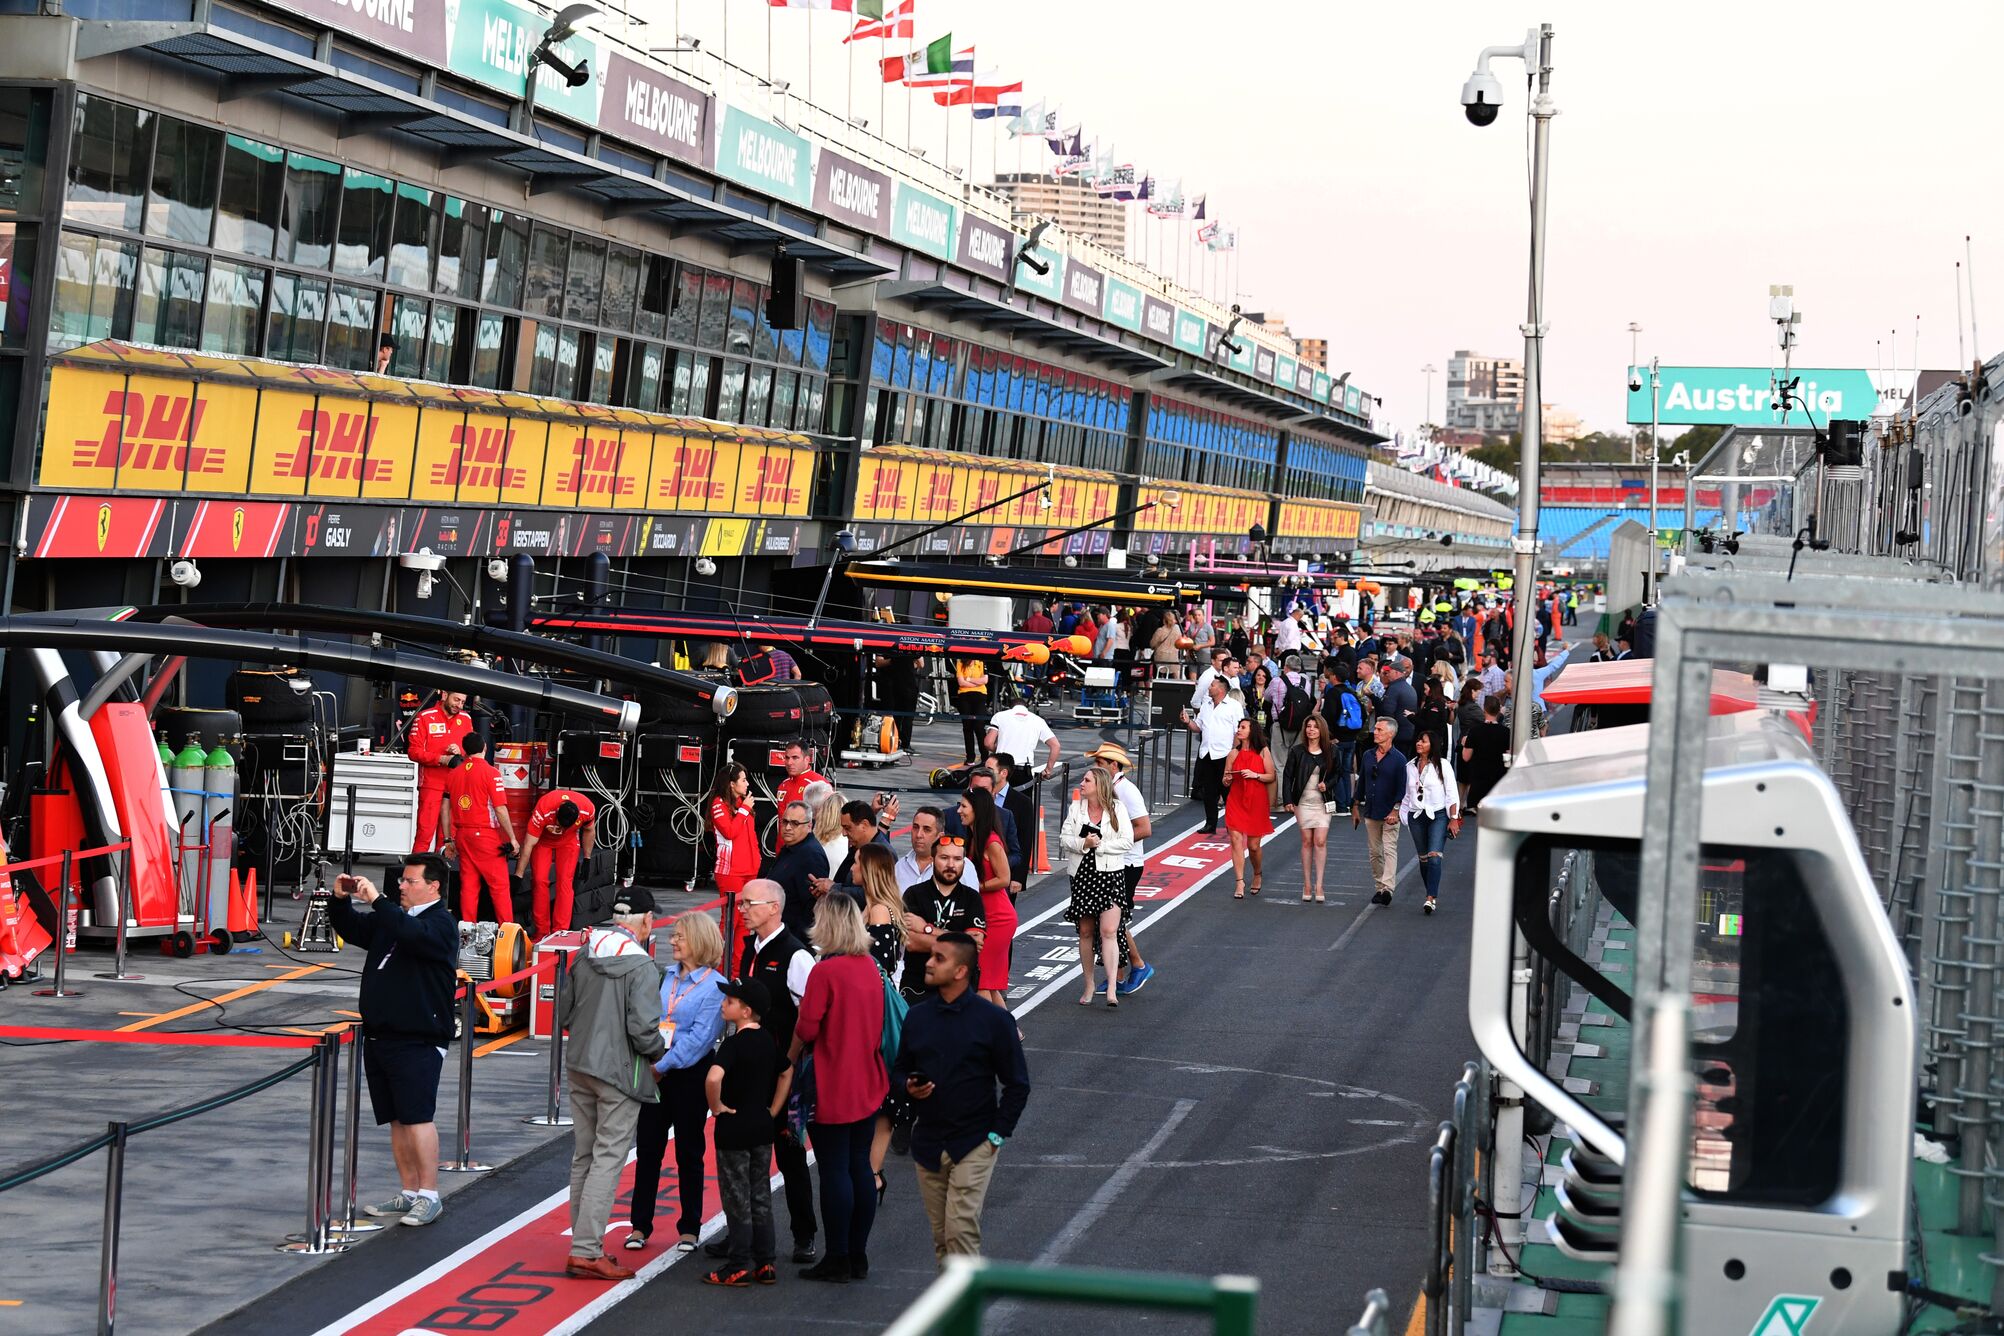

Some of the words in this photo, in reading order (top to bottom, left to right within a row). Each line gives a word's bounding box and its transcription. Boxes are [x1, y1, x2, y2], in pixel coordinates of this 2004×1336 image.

[624, 74, 699, 148] MELBOURNE
[737, 126, 798, 188] MELBOURNE
[828, 165, 880, 219] MELBOURNE
[905, 199, 948, 246] MELBOURNE
[968, 226, 1006, 269] MELBOURNE
[95, 390, 208, 473] DHL
[289, 409, 380, 482] DHL
[443, 424, 516, 488] DHL
[566, 437, 627, 495] DHL
[669, 446, 719, 499] DHL
[752, 455, 797, 504] DHL
[868, 467, 904, 509] DHL
[925, 472, 955, 512] DHL
[325, 527, 351, 547] GASLY
[513, 530, 550, 548] VERSTAPPEN
[898, 643, 911, 651] Red
[911, 644, 924, 652] Bull
[414, 1261, 580, 1331] BOT
